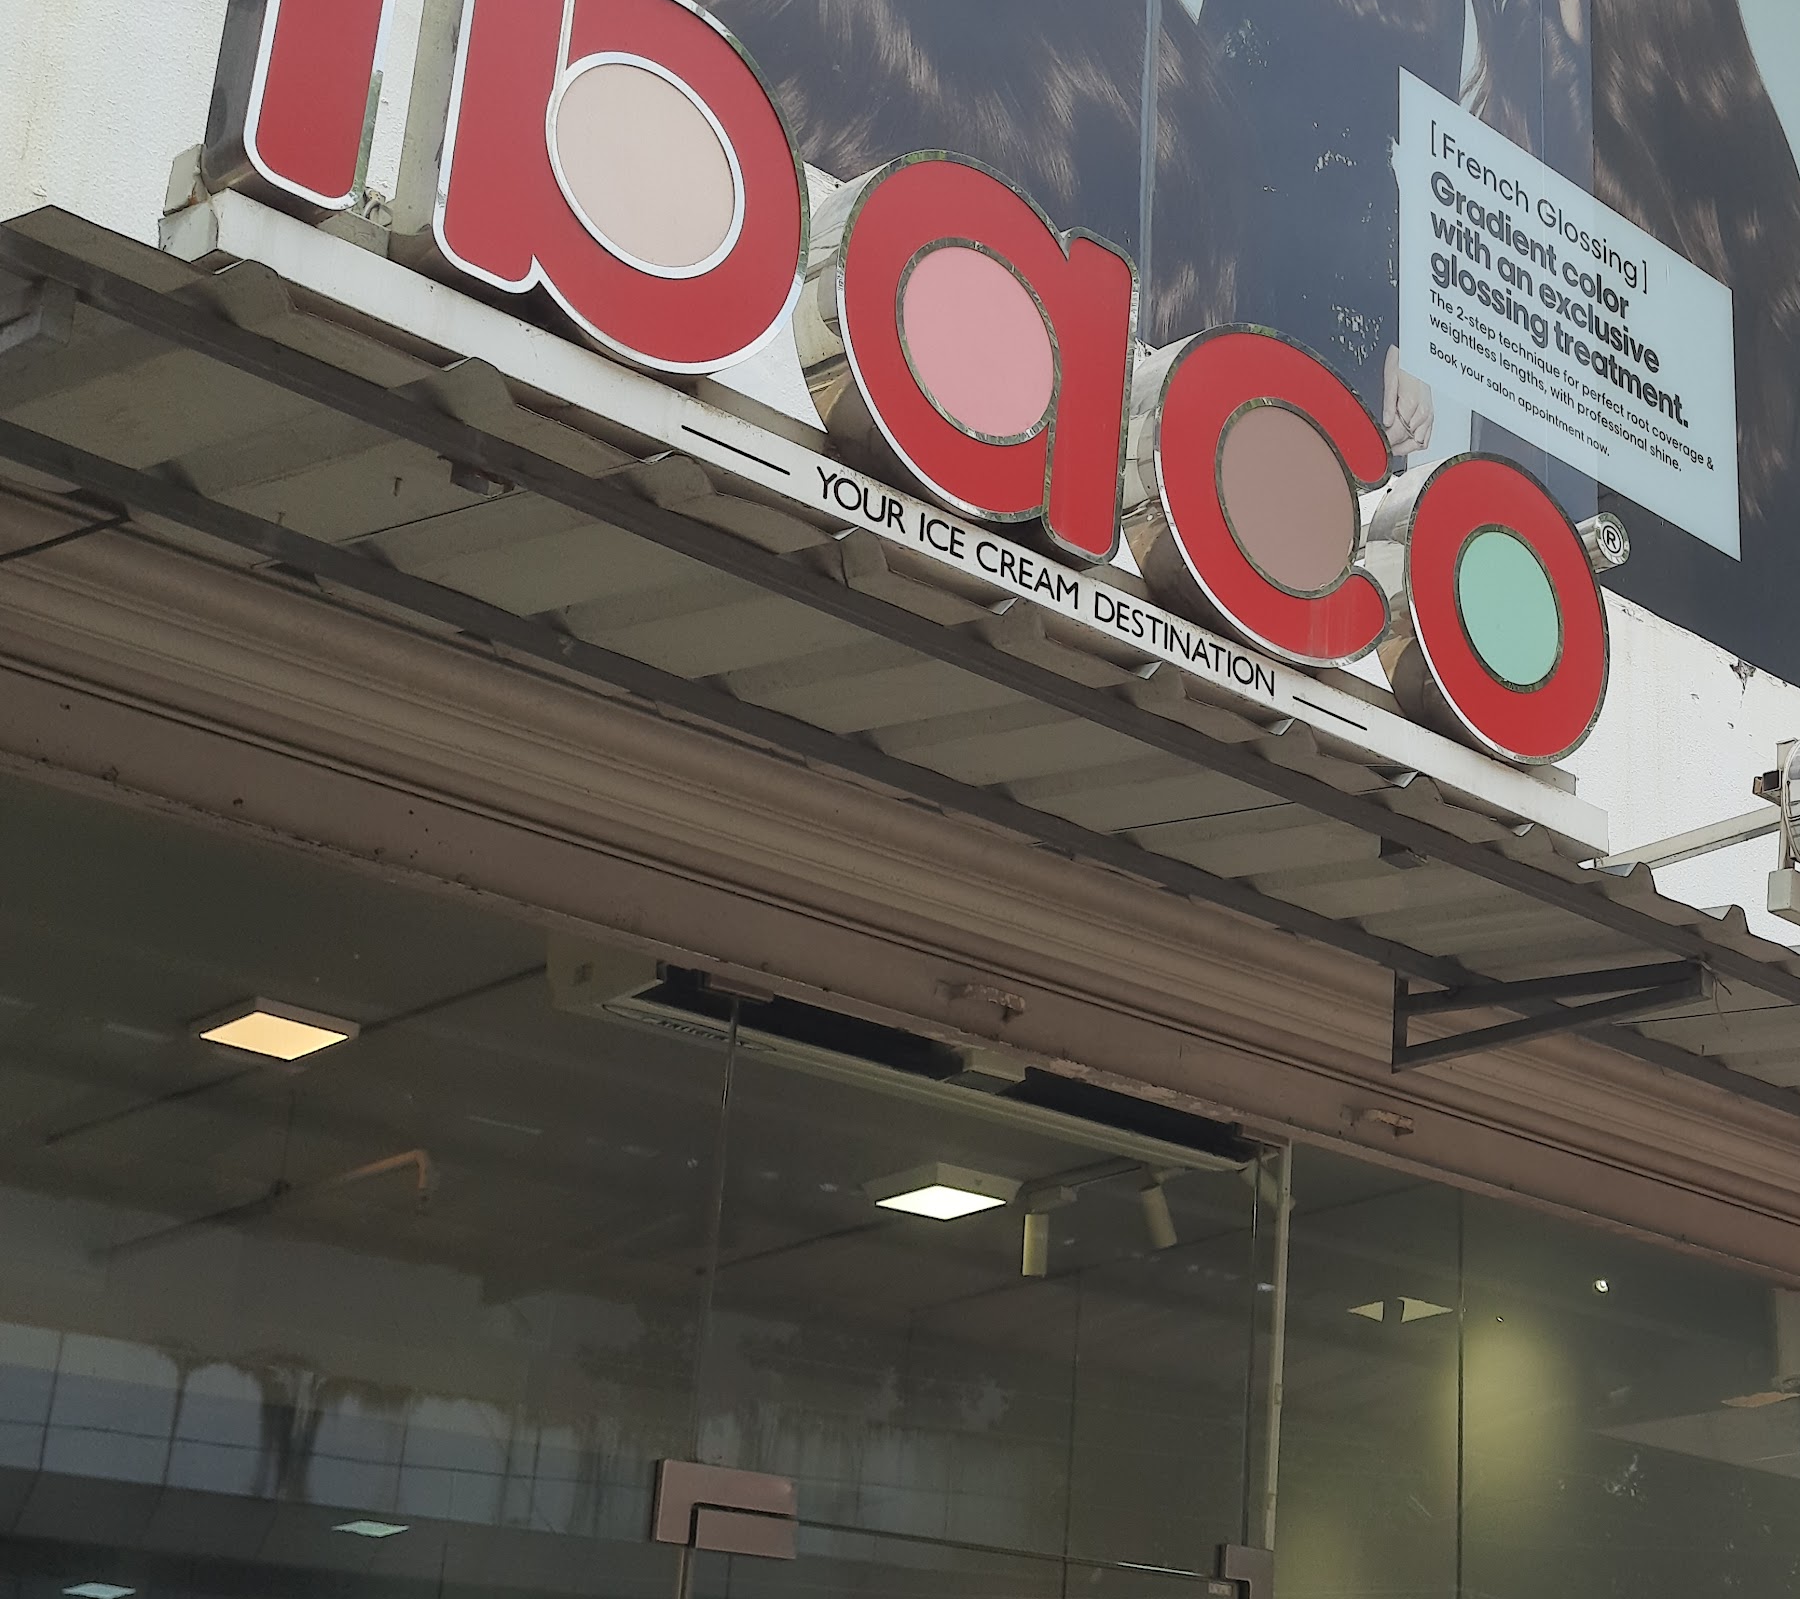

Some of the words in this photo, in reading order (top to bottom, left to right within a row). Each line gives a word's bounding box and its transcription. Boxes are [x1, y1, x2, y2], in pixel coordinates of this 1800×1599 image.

[1430, 171, 1557, 277] Gradient
[1562, 261, 1630, 320] color
[1430, 211, 1491, 271] with
[1497, 256, 1533, 297] an
[1539, 282, 1660, 374] exclusive
[1429, 289, 1454, 314] The
[1456, 306, 1496, 341] 2-step
[1498, 331, 1561, 378] technique
[1563, 370, 1580, 390] for
[1582, 382, 1625, 418] perfect
[1626, 409, 1650, 433] root
[1652, 426, 1704, 464] coverage
[1706, 456, 1715, 471] &
[1429, 314, 1497, 363] weightless
[1499, 352, 1548, 395] lengths,
[1550, 385, 1575, 410] with
[1577, 401, 1648, 452] professional
[1649, 443, 1682, 472] shine.
[1429, 342, 1458, 369] Book
[1460, 362, 1485, 384] your
[1486, 377, 1516, 403] salon
[1517, 396, 1585, 442] appointment
[1586, 433, 1610, 457] now.
[1430, 252, 1549, 349] glossing
[1553, 320, 1689, 428] treatment.
[815, 465, 906, 533] YOUR
[918, 511, 965, 559] ICE
[975, 541, 1079, 611] CREAM
[1093, 591, 1276, 698] DESTINATION
